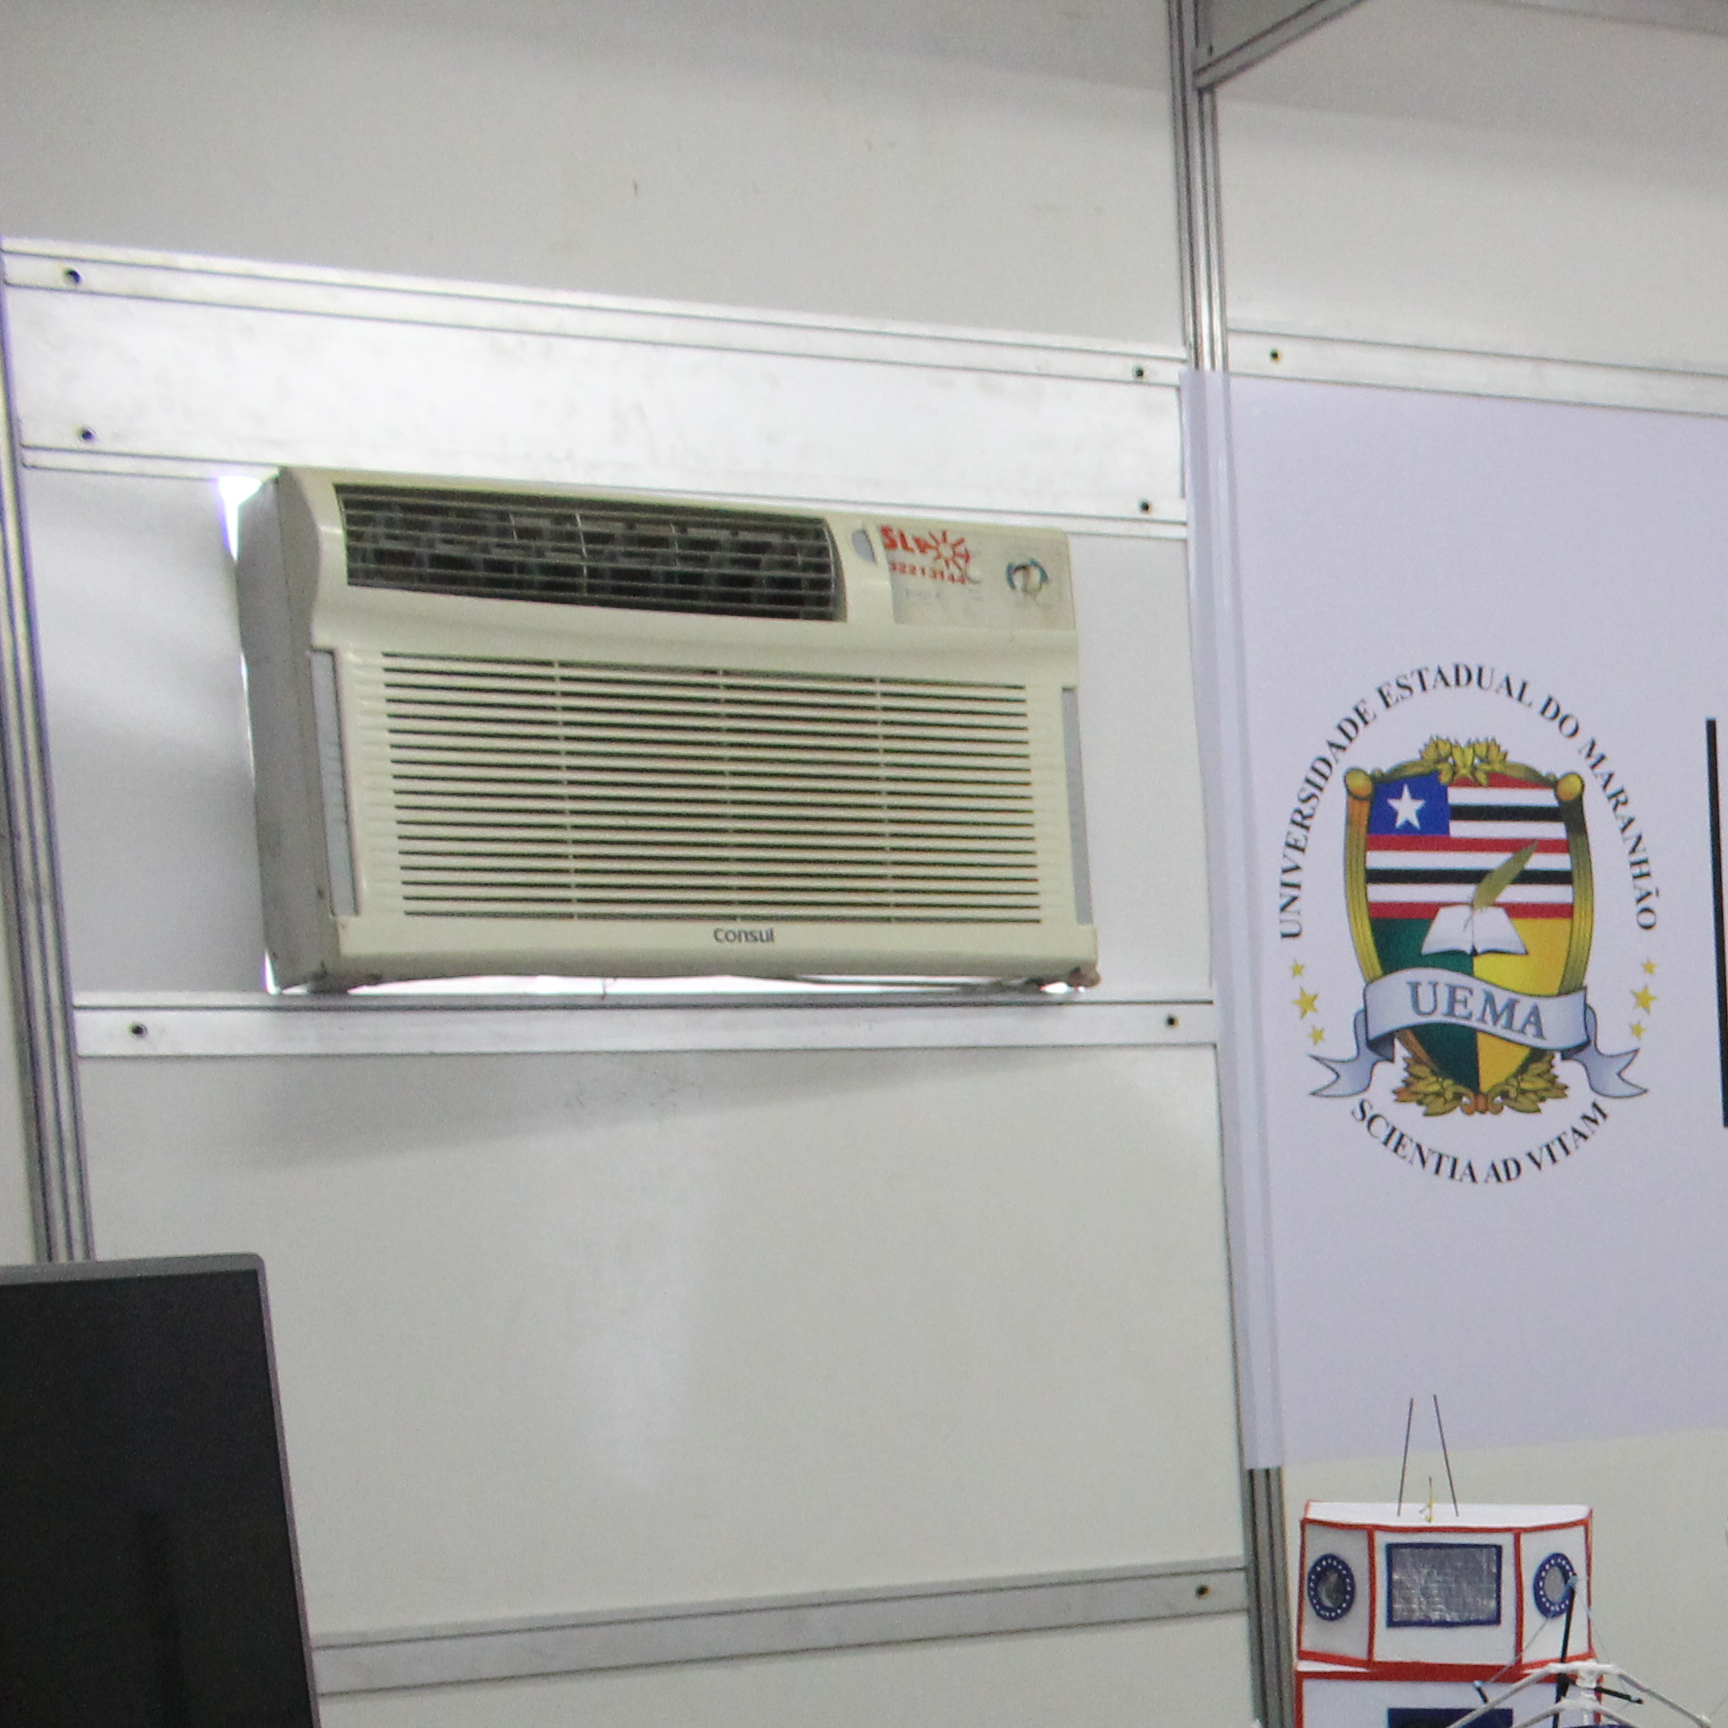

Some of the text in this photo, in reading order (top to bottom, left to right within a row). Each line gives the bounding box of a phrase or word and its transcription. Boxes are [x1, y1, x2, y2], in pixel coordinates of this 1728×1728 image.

[1279, 662, 1661, 940] UNIVERSIDADE ESTADUAL DO MARANHÃO
[713, 927, 774, 943] Consul
[1406, 980, 1547, 1040] UEMA
[1351, 1099, 1611, 1185] SCIENTIA AD VITAM
